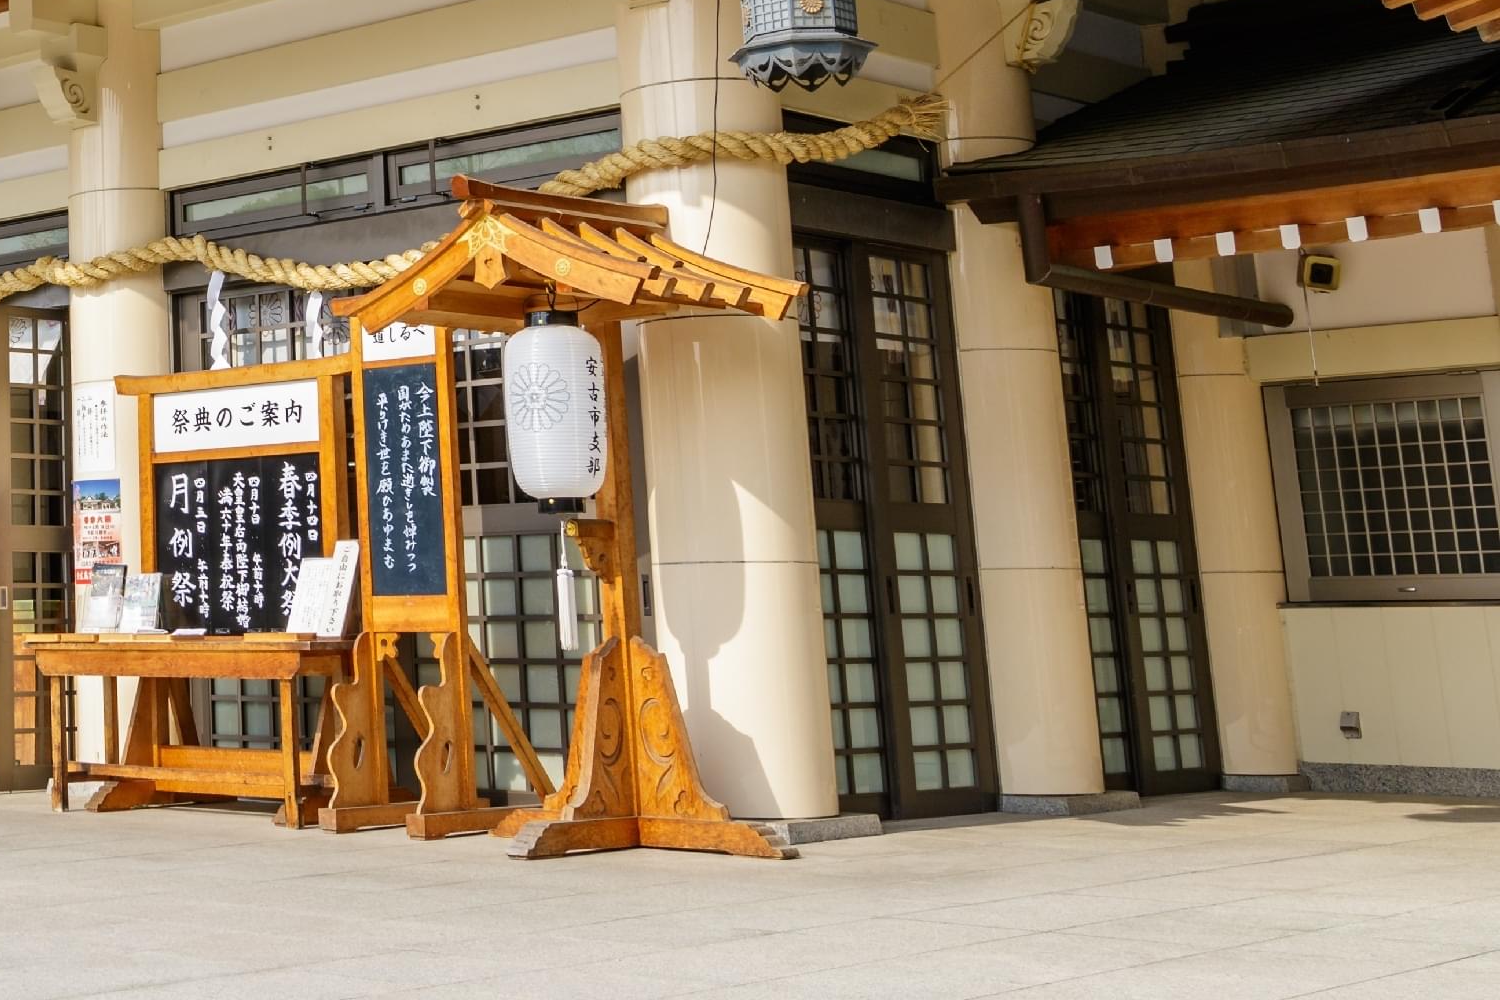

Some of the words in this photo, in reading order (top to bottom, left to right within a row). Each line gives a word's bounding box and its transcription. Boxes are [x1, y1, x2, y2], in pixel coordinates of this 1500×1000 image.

[172, 398, 303, 434] 祭典のご案内
[415, 381, 437, 496] 今上陛下御製
[585, 356, 601, 478] 安古市支部
[169, 472, 196, 607] 月例祭
[218, 486, 235, 612] 満六十年奉祝祭
[233, 472, 251, 628] 天皇皇后両陛下御結婚
[248, 476, 260, 525] 四月十日
[278, 461, 302, 616] 春季例大祭
[304, 471, 319, 541] 四月十四日
[197, 559, 210, 618] 午前十時
[252, 552, 264, 608] 午前十時
